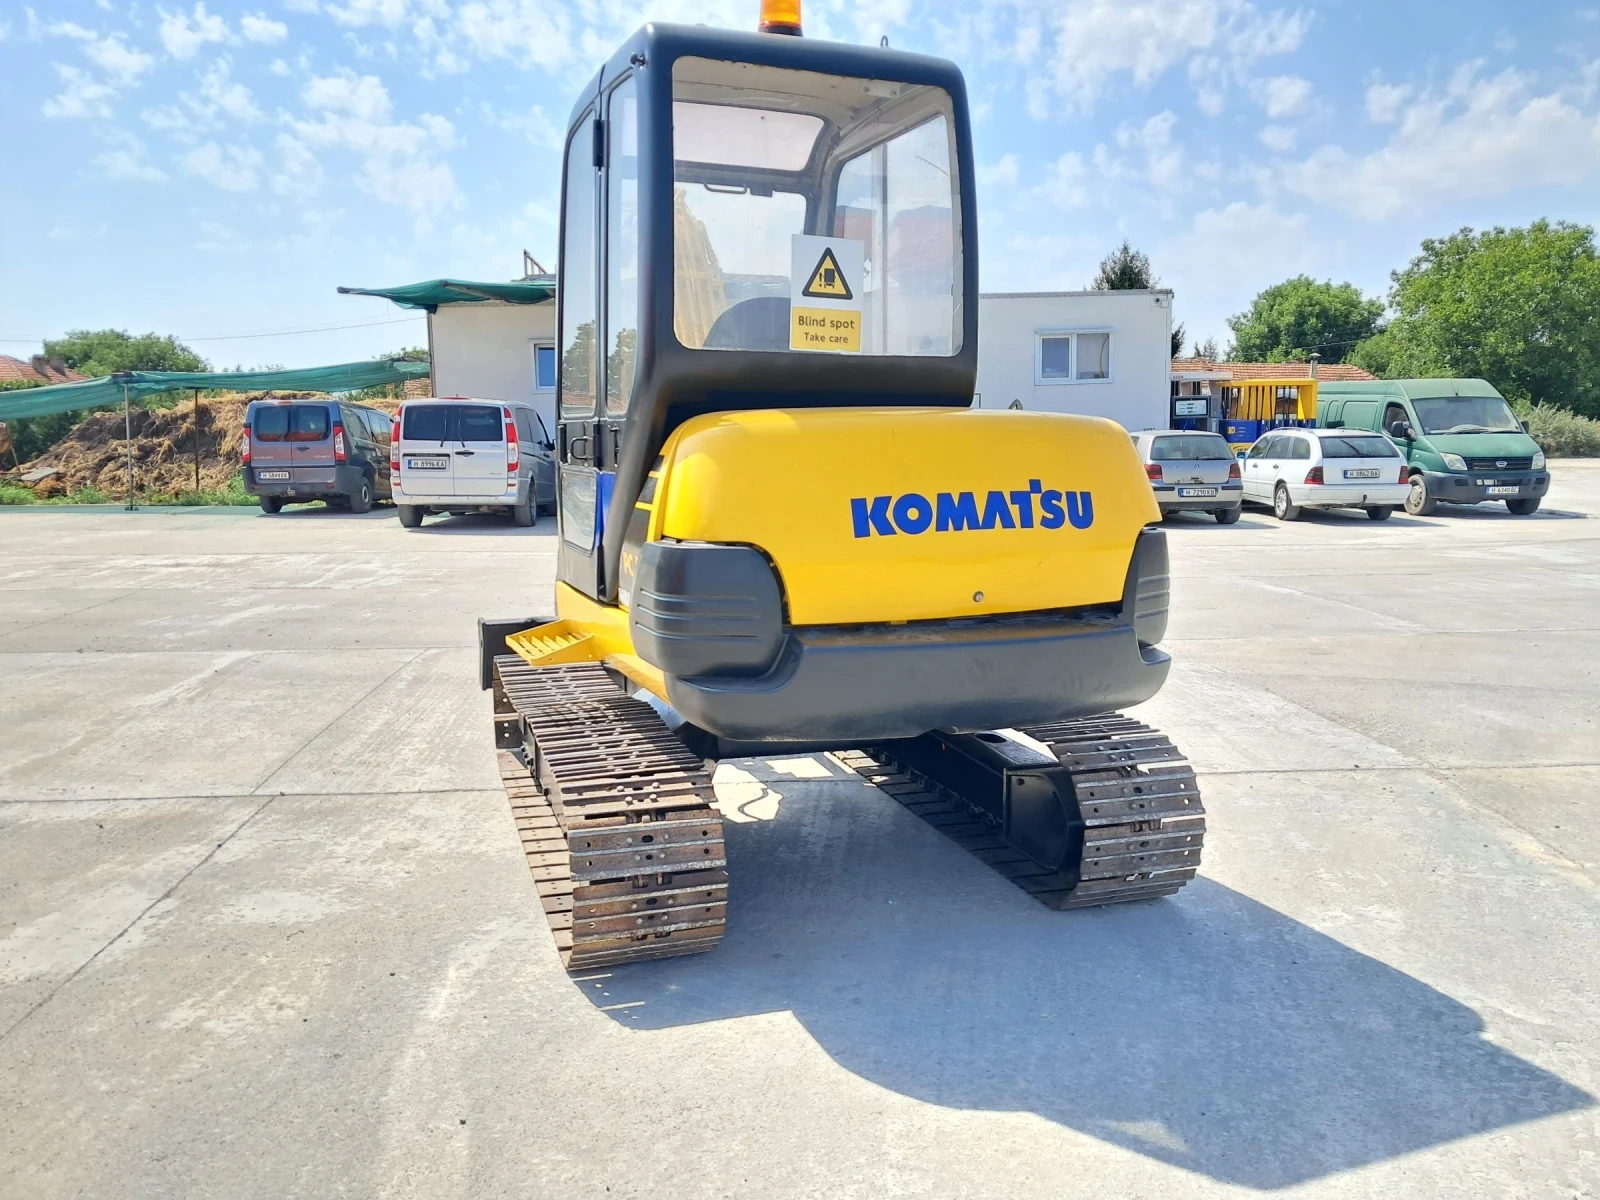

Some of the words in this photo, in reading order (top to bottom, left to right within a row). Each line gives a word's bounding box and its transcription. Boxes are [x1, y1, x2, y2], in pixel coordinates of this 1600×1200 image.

[798, 315, 826, 327] Blind
[830, 319, 855, 331] spot
[803, 332, 826, 343] Take
[829, 335, 849, 344] care
[850, 479, 1093, 538] KOMATSU
